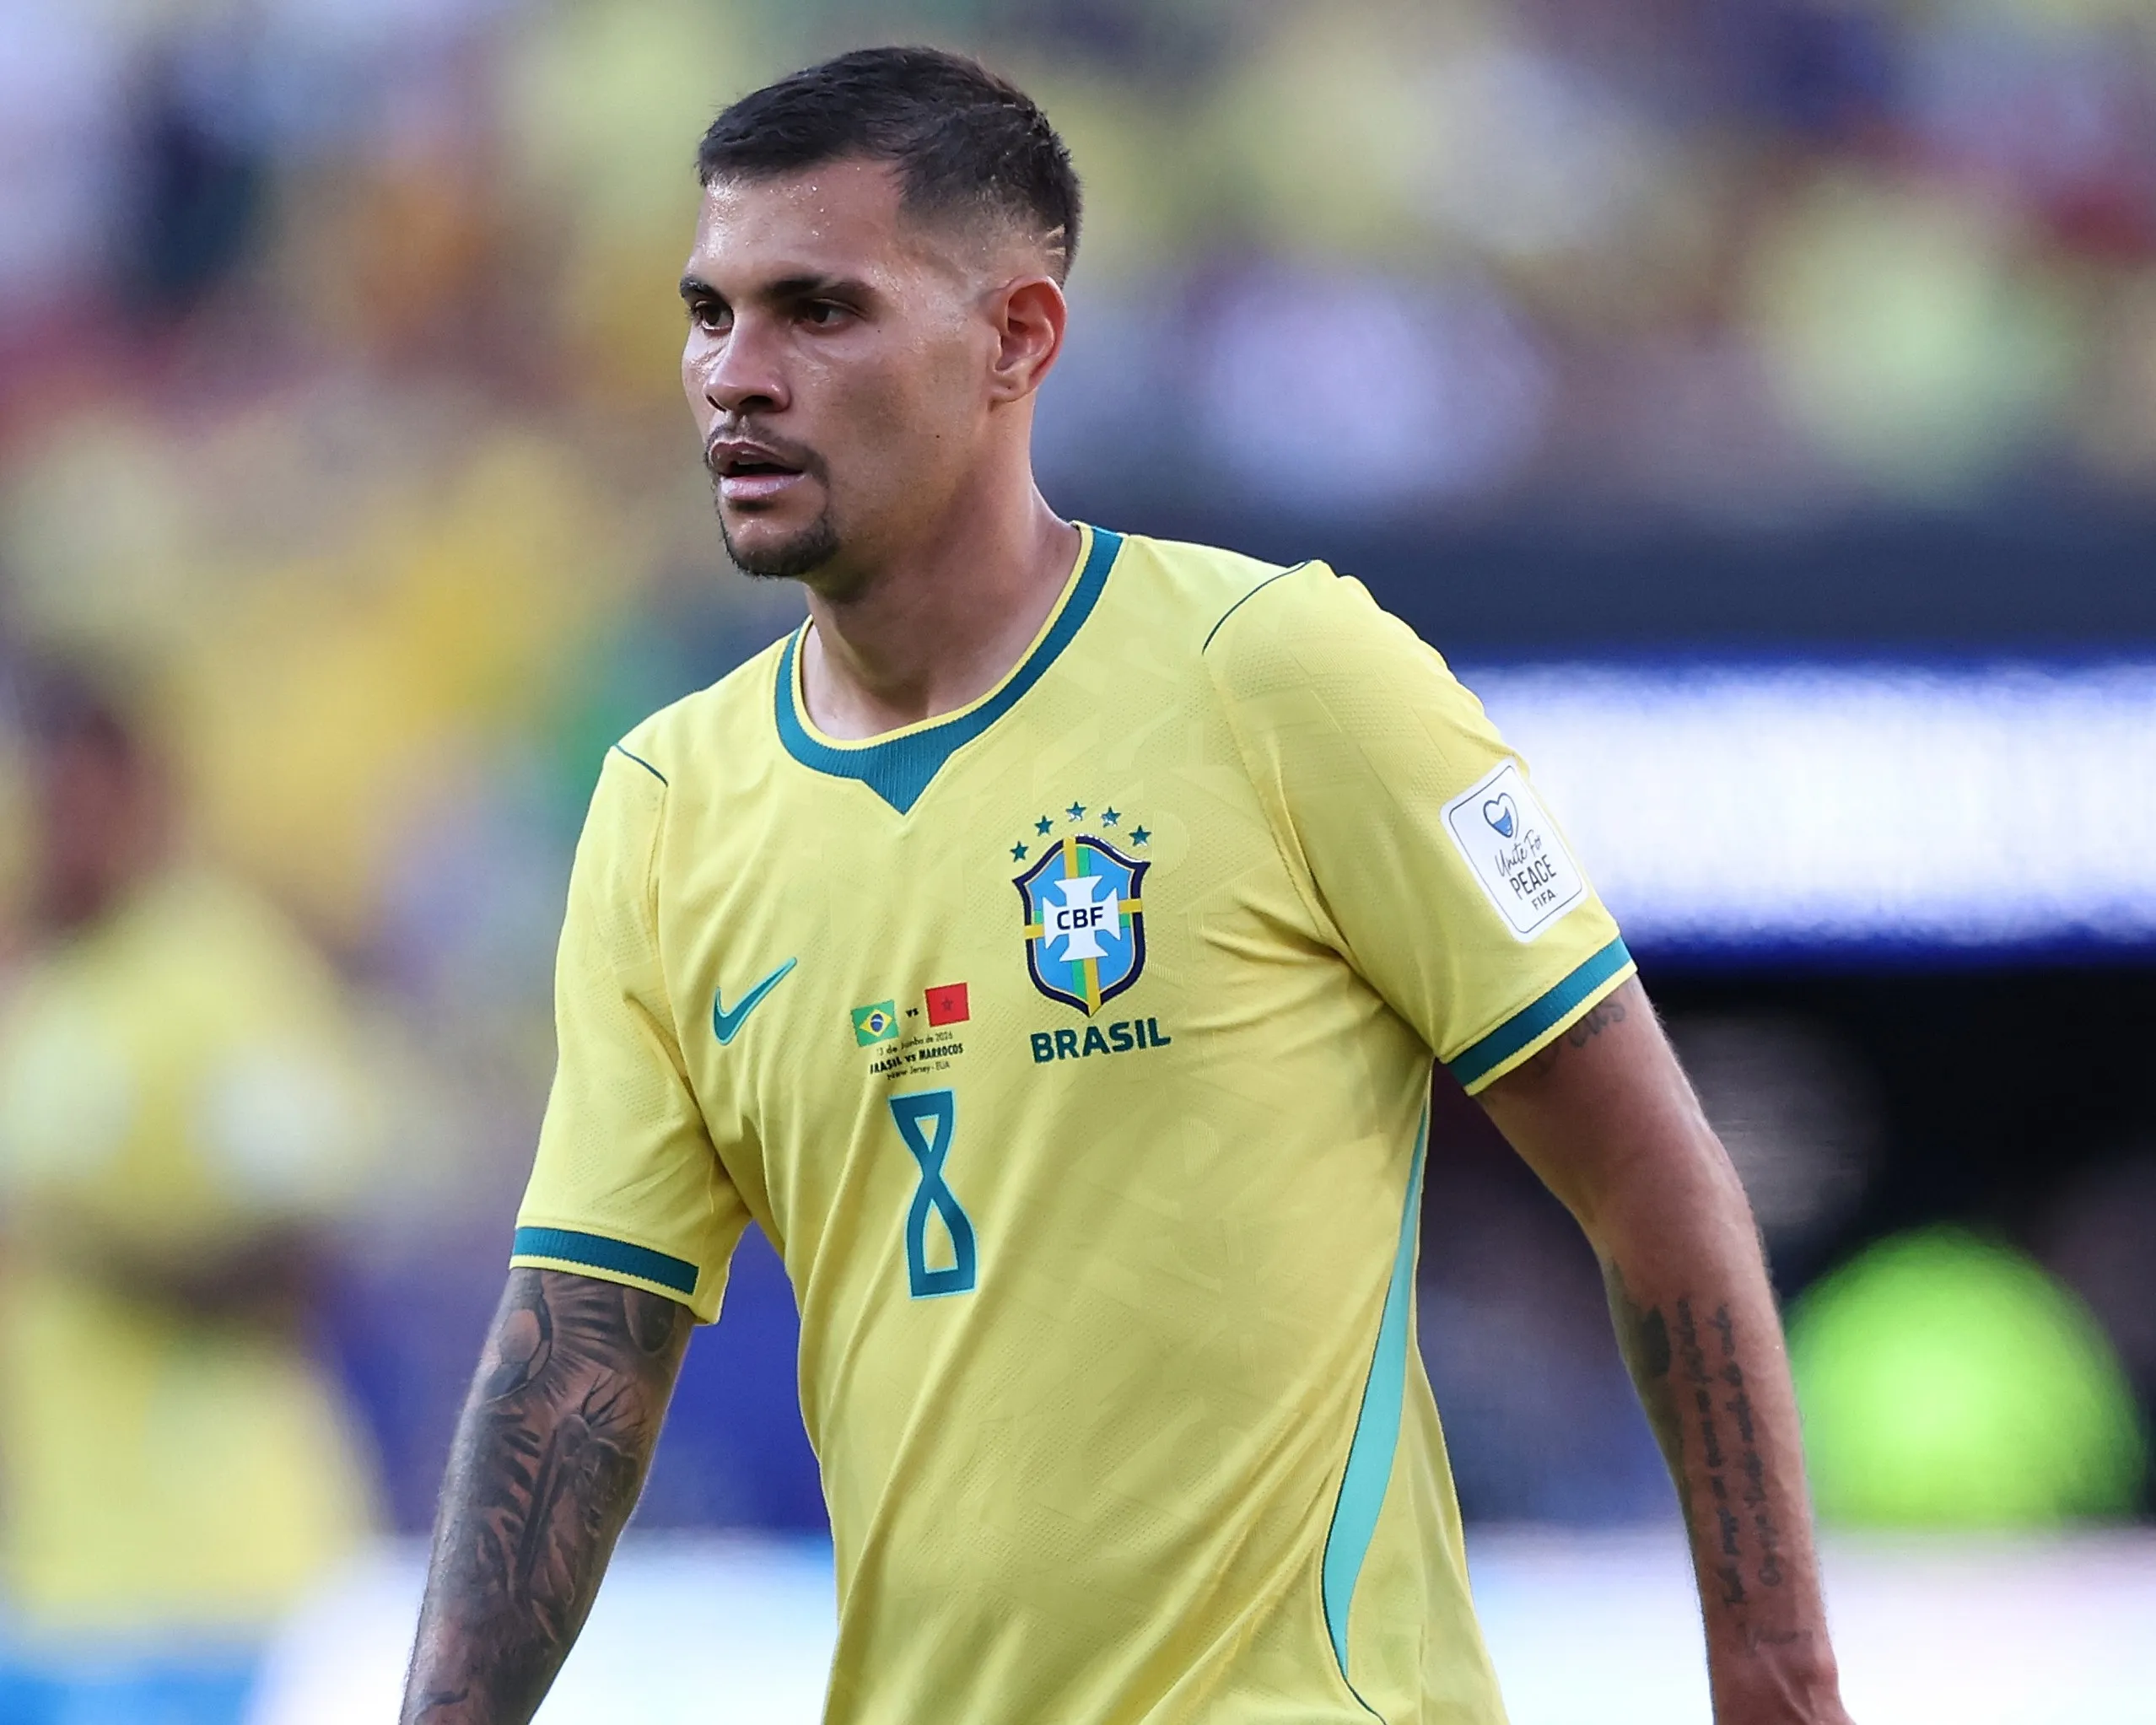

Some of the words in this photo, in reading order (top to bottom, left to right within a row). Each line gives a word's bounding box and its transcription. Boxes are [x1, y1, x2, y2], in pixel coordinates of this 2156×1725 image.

[1495, 843, 1528, 877] Unite
[1523, 828, 1543, 857] For
[1509, 854, 1557, 901] PEACE
[1531, 888, 1557, 911] FIFA
[1056, 906, 1104, 931] CBF
[887, 1044, 898, 1054] de
[904, 1054, 917, 1063] vs
[919, 1043, 964, 1060] MARROCOS
[1030, 1017, 1172, 1064] BRASIL
[888, 1088, 978, 1299] 8
